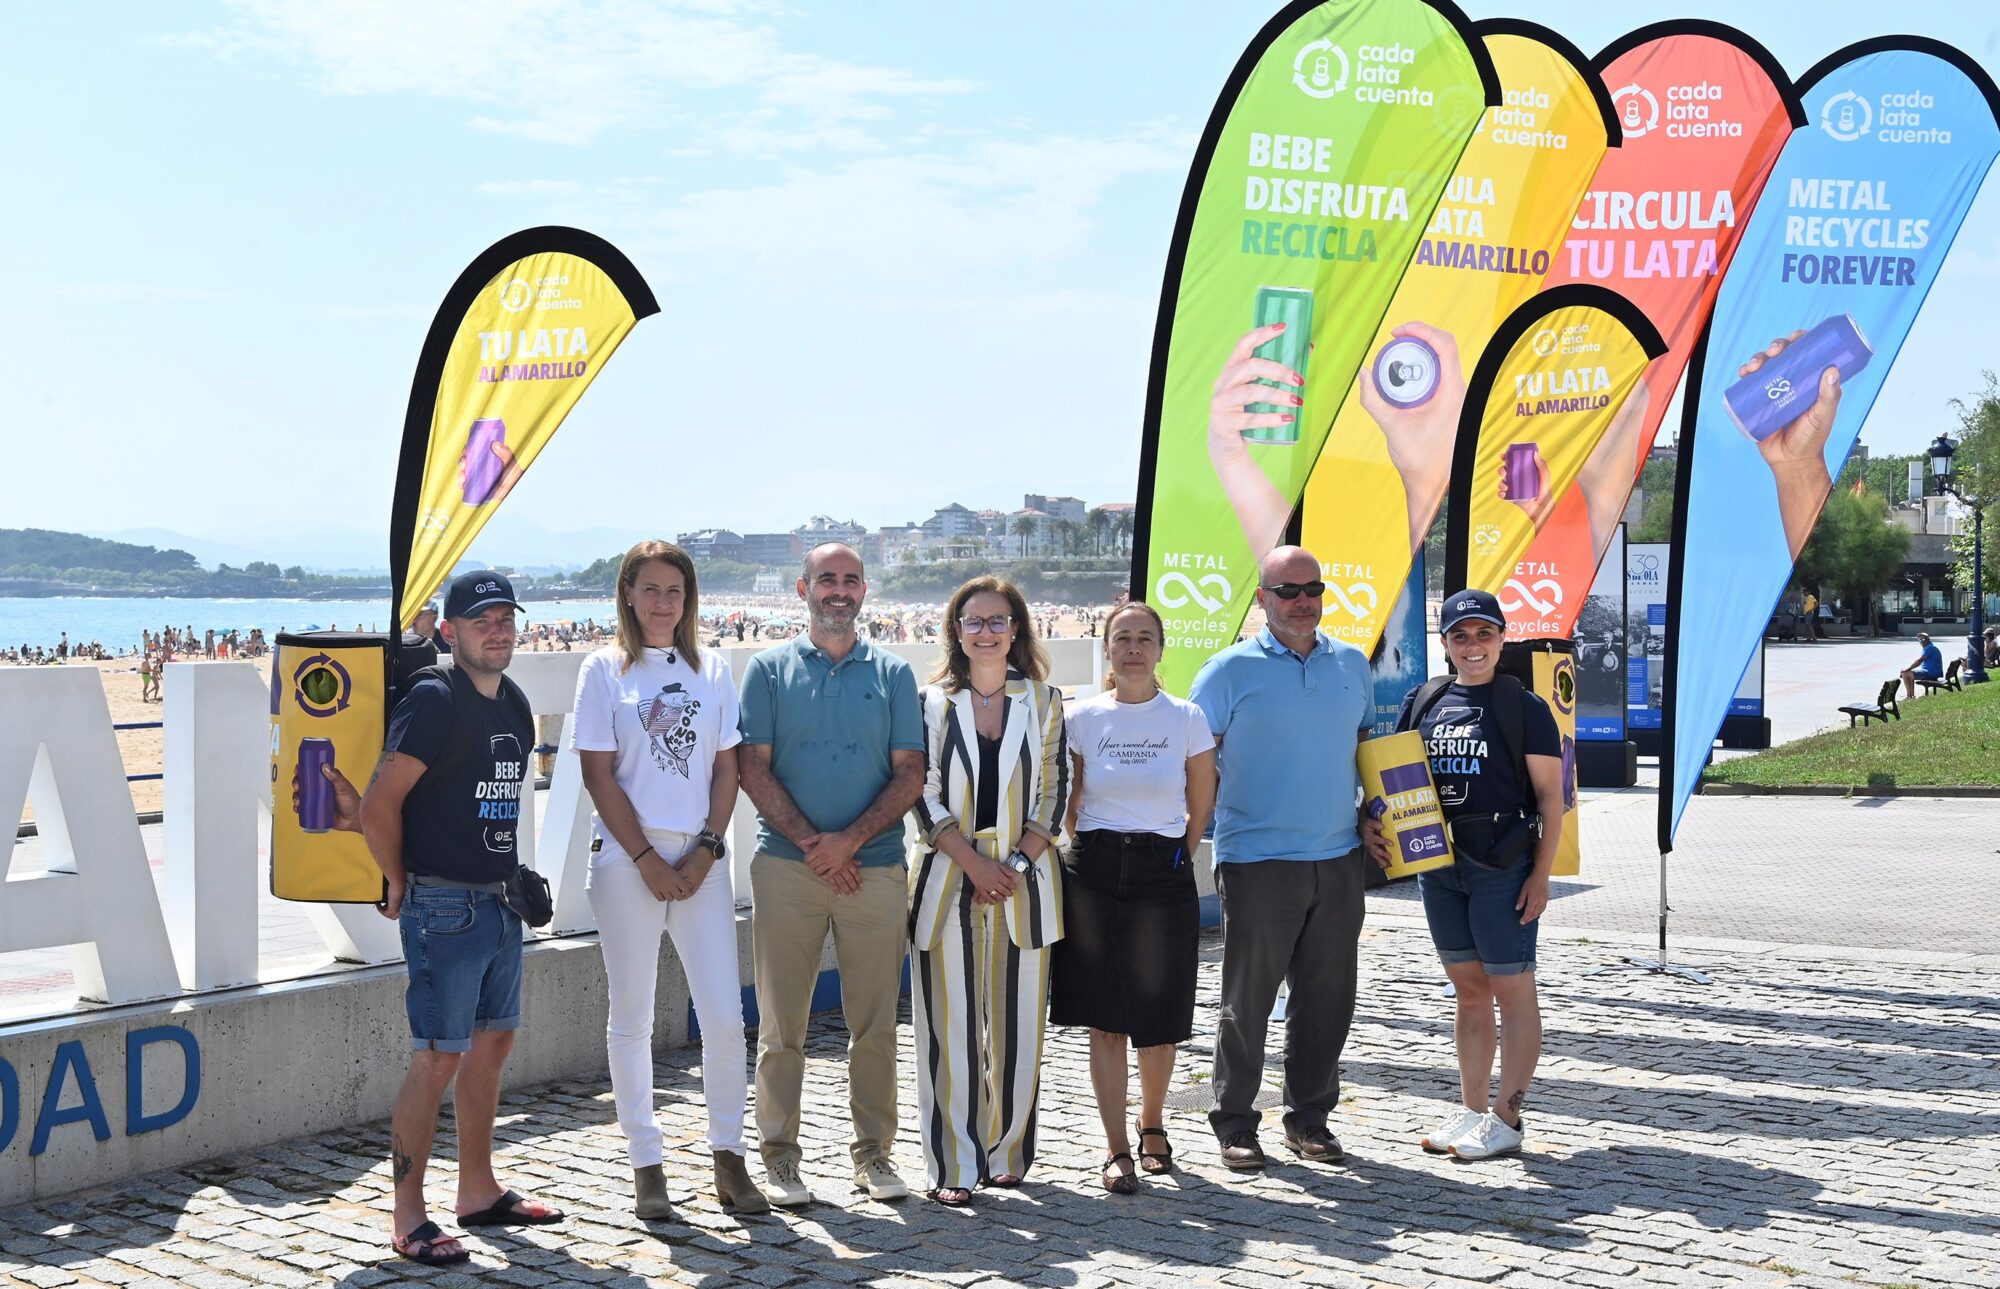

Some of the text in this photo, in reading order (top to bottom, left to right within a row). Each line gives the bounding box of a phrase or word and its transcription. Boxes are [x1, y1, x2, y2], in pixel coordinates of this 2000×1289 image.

[1358, 42, 1415, 64] cada
[1357, 61, 1401, 84] lata
[1355, 86, 1434, 107] cuenta
[1502, 84, 1550, 108] ada
[1666, 81, 1722, 101] cada
[1880, 90, 1934, 109] cada
[1666, 101, 1709, 120] lata
[1879, 108, 1920, 127] lata
[1666, 120, 1742, 138] cuenta
[1878, 128, 1952, 144] cuenta
[1492, 128, 1568, 150] cuenta
[1248, 132, 1333, 173] BEBE
[1245, 176, 1409, 221] DISFRUTA
[1788, 178, 1891, 211] METAL
[1571, 189, 1735, 230] CIRCULA
[1241, 219, 1378, 262] RECICLA
[1785, 215, 1930, 250] RECYCLES
[1416, 239, 1550, 276] AMARILLO
[1565, 239, 1718, 279] TU LATA
[1781, 253, 1916, 286] FOREVER
[536, 273, 569, 287] cada
[535, 298, 582, 311] cuenta
[1561, 323, 1590, 335] cada
[478, 327, 589, 361] TU LATA
[1561, 334, 1584, 345] lata
[1561, 344, 1601, 354] cuenta
[478, 360, 587, 383] AL AMARILLO
[1515, 366, 1611, 398] TU LATA
[1515, 394, 1610, 417] AL AMARILLO
[1163, 552, 1228, 570] METAL
[1514, 562, 1559, 576] ETAL
[1162, 617, 1228, 634] ecycles
[1320, 623, 1373, 640] cycles
[1506, 619, 1560, 635] cycles
[1165, 636, 1222, 649] orever
[1377, 722, 1384, 734] 27
[1432, 724, 1474, 739] BEBE
[1097, 736, 1169, 758] Your sweet smile
[1424, 739, 1488, 758] ISFRUTA
[495, 761, 520, 780] BEBE
[1430, 757, 1481, 774] ECICLA
[475, 781, 522, 800] DISFRUT
[1388, 796, 1406, 811] TU
[1407, 789, 1436, 807] LATA
[478, 801, 521, 820] RECICL
[1392, 804, 1439, 821] AL AMARILLO
